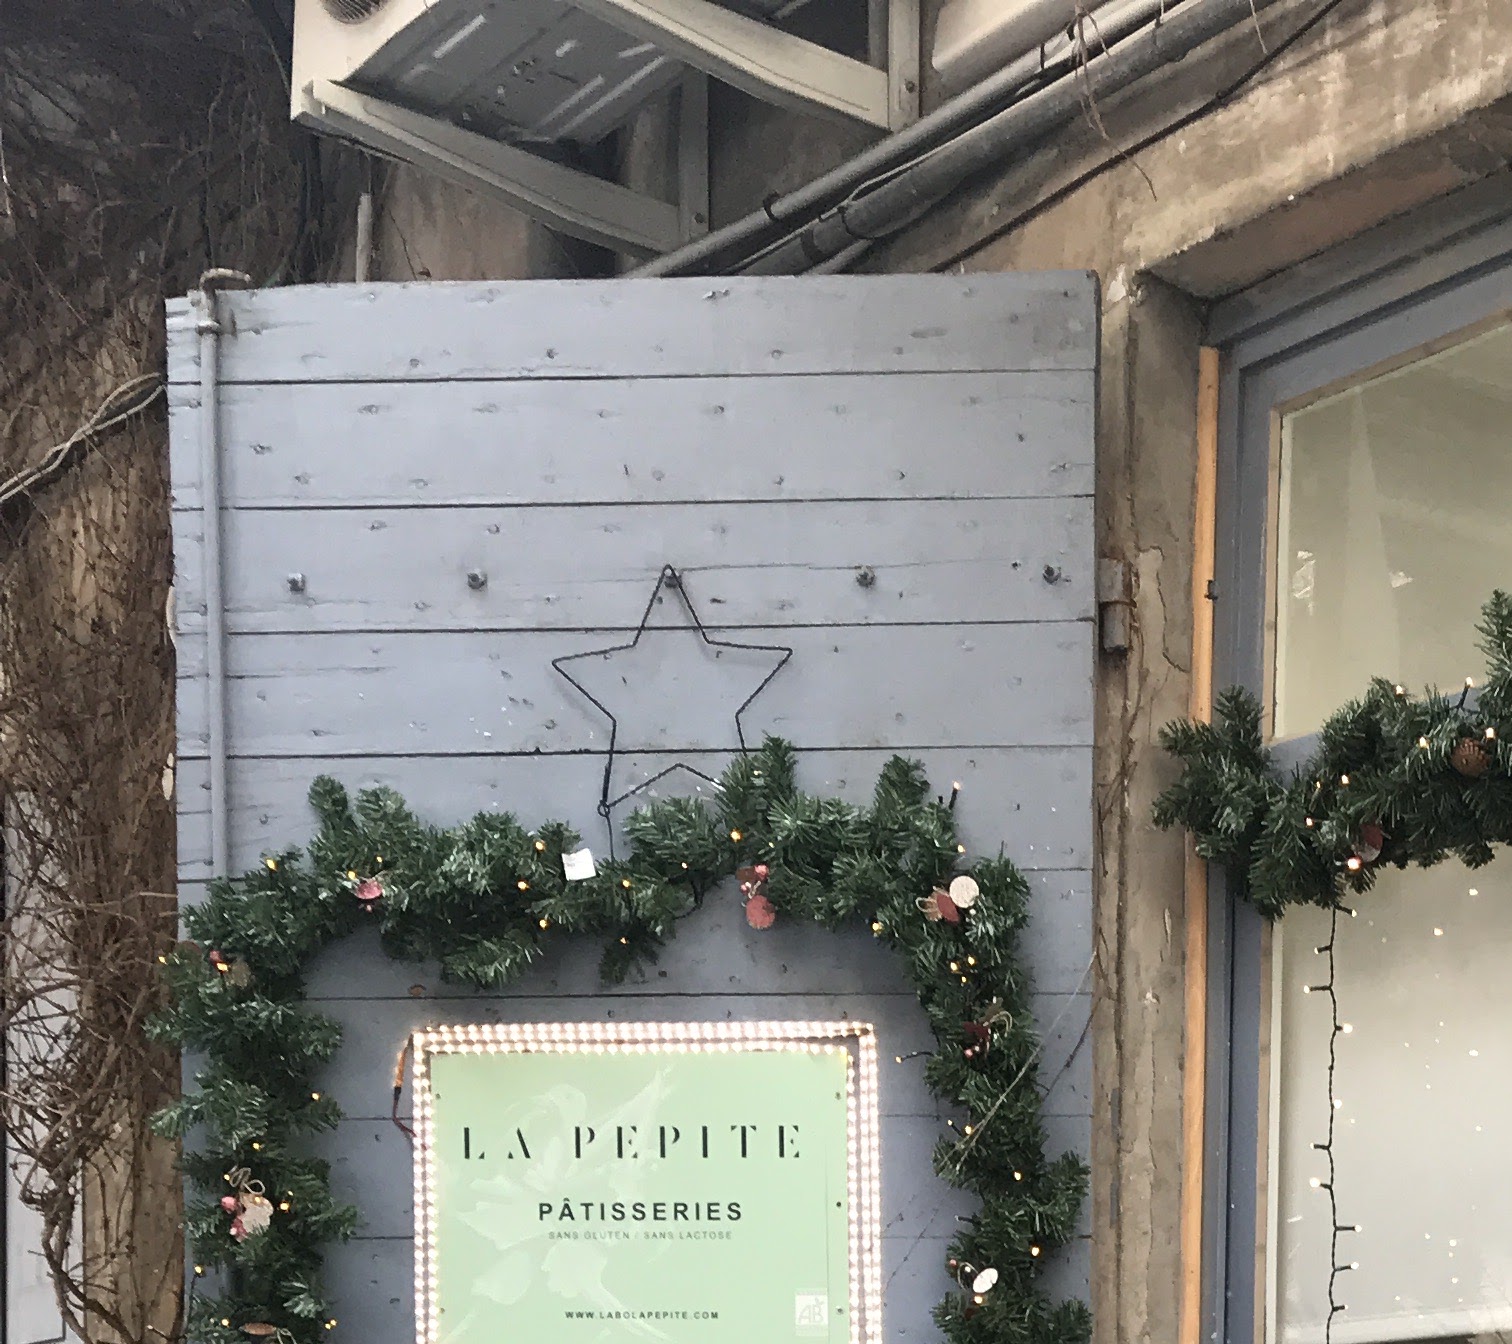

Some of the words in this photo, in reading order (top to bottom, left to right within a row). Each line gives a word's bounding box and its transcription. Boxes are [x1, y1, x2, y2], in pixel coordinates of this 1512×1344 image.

[463, 1126, 532, 1160] LA
[574, 1125, 801, 1158] PEPITE
[538, 1197, 743, 1222] PÂTISSERIES
[548, 1230, 579, 1241] SANS
[583, 1230, 631, 1241] GLUTEN
[643, 1230, 675, 1241] SANS
[679, 1230, 733, 1241] LACTOSE
